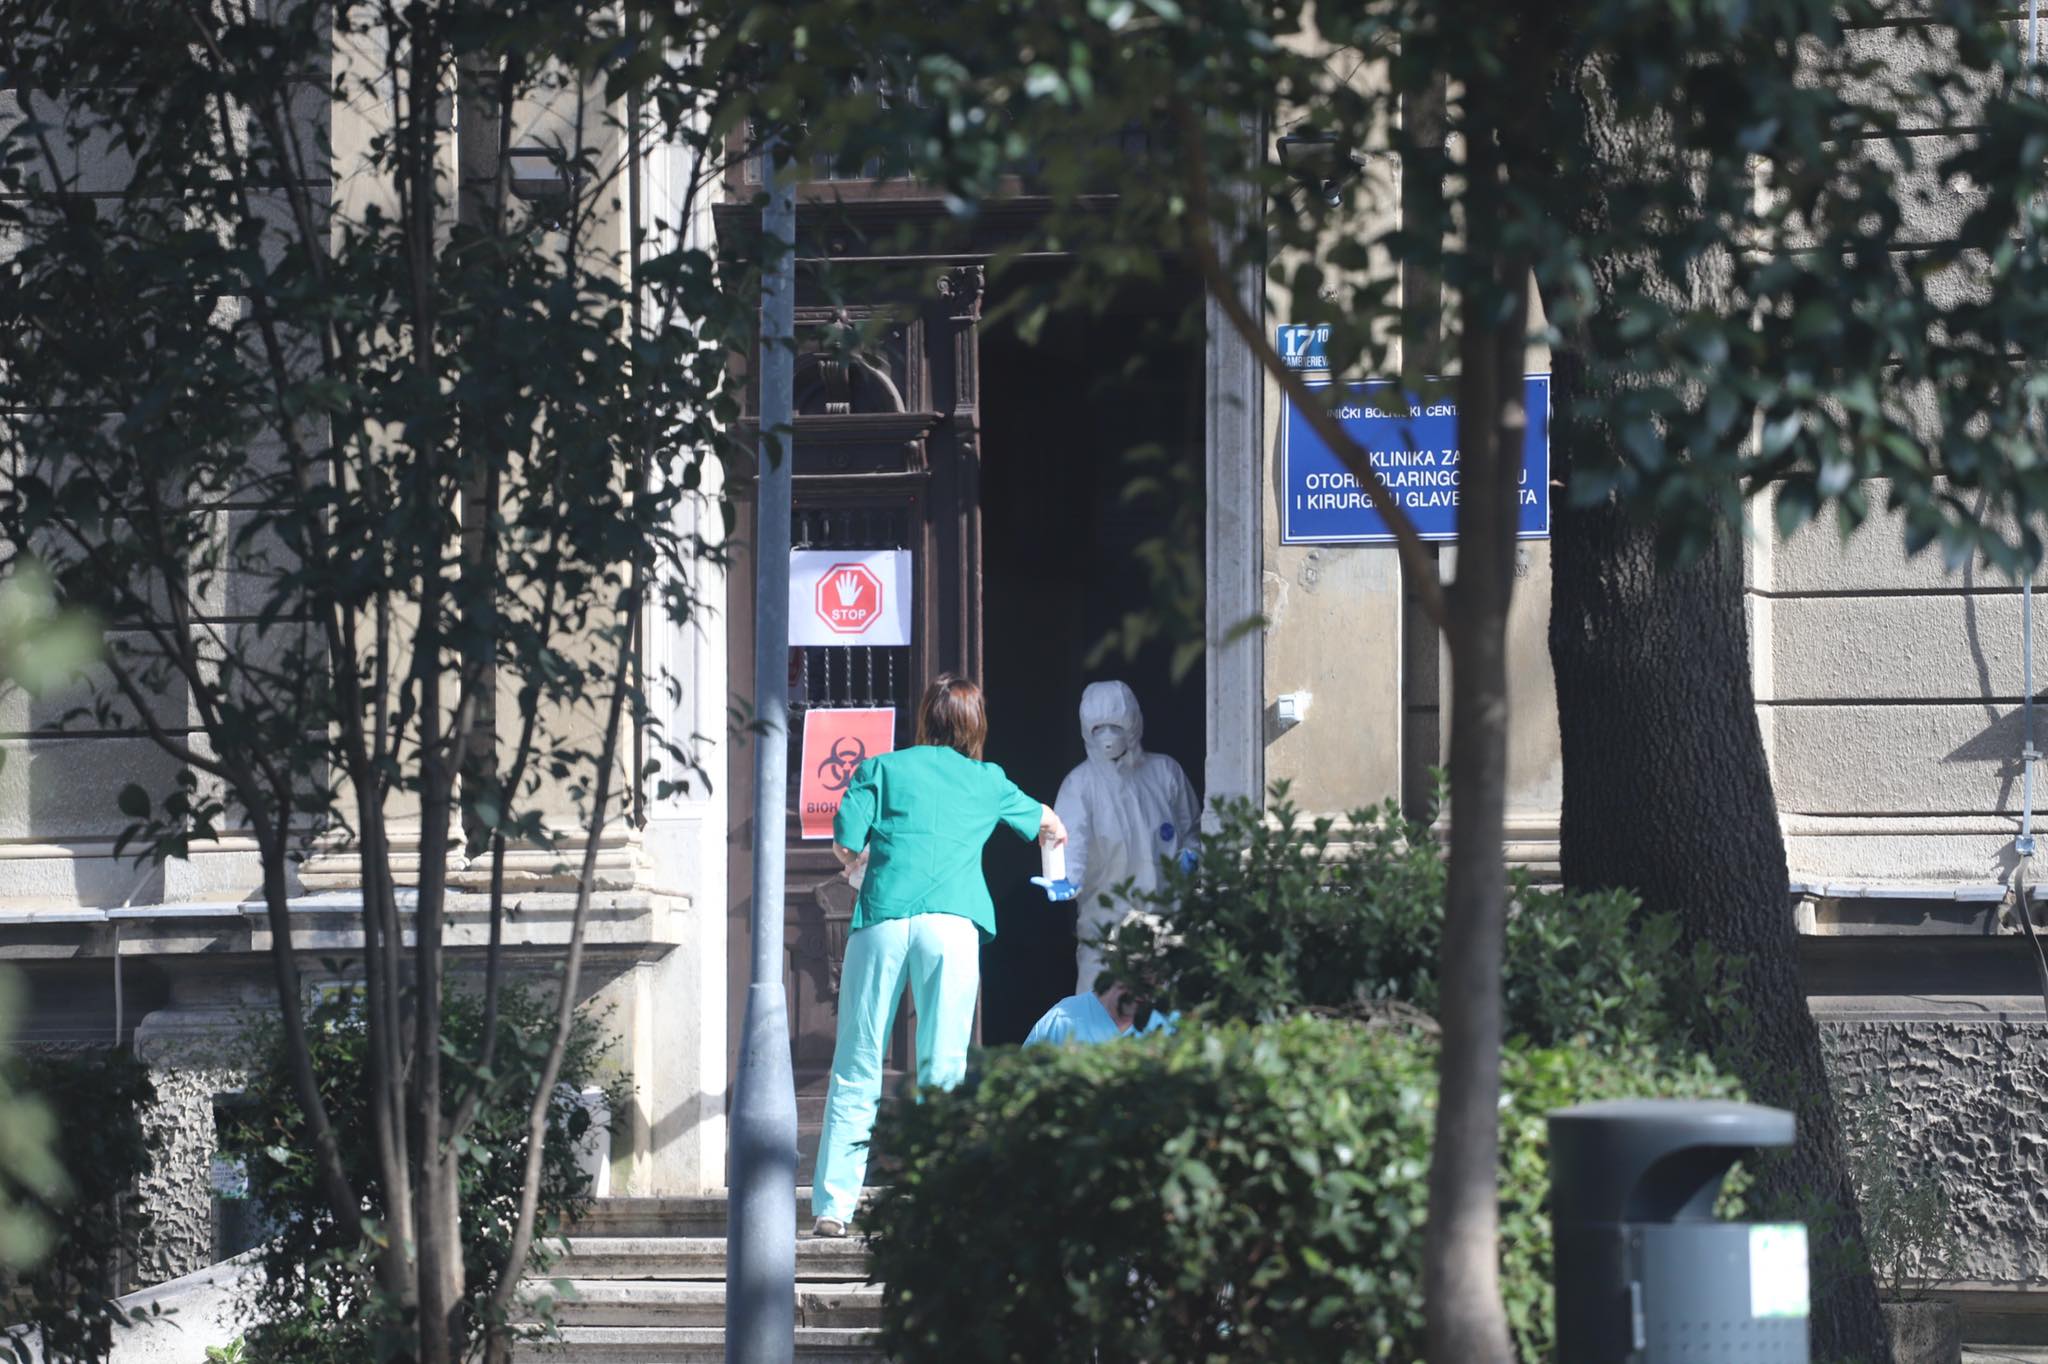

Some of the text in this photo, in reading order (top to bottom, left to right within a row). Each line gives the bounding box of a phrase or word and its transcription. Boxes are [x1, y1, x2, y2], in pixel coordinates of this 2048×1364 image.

[1284, 329, 1316, 356] 17
[1369, 449, 1461, 467] KLINIKA ZA
[1297, 494, 1301, 510] I
[1406, 490, 1461, 508] GLAVE
[832, 609, 867, 621] STOP
[807, 802, 838, 813] BIOH
